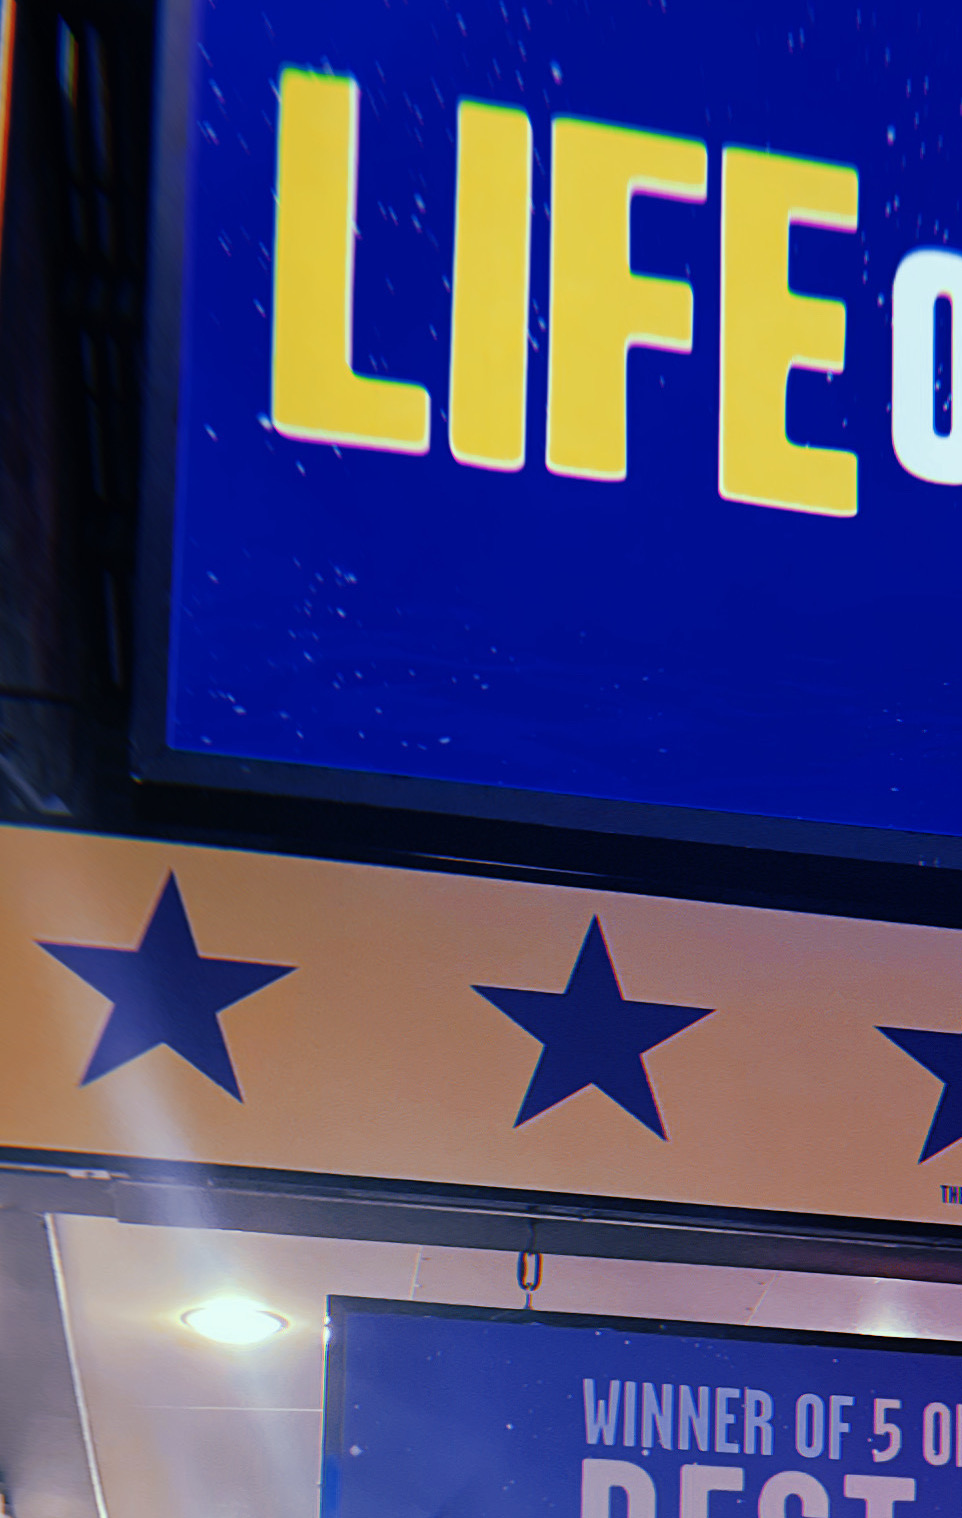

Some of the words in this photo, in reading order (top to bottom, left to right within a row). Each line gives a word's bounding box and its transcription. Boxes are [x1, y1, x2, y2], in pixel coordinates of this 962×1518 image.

[272, 66, 858, 517] LIFE
[582, 1378, 774, 1456] WINNER
[795, 1393, 854, 1460] OF
[872, 1398, 901, 1462] 5
